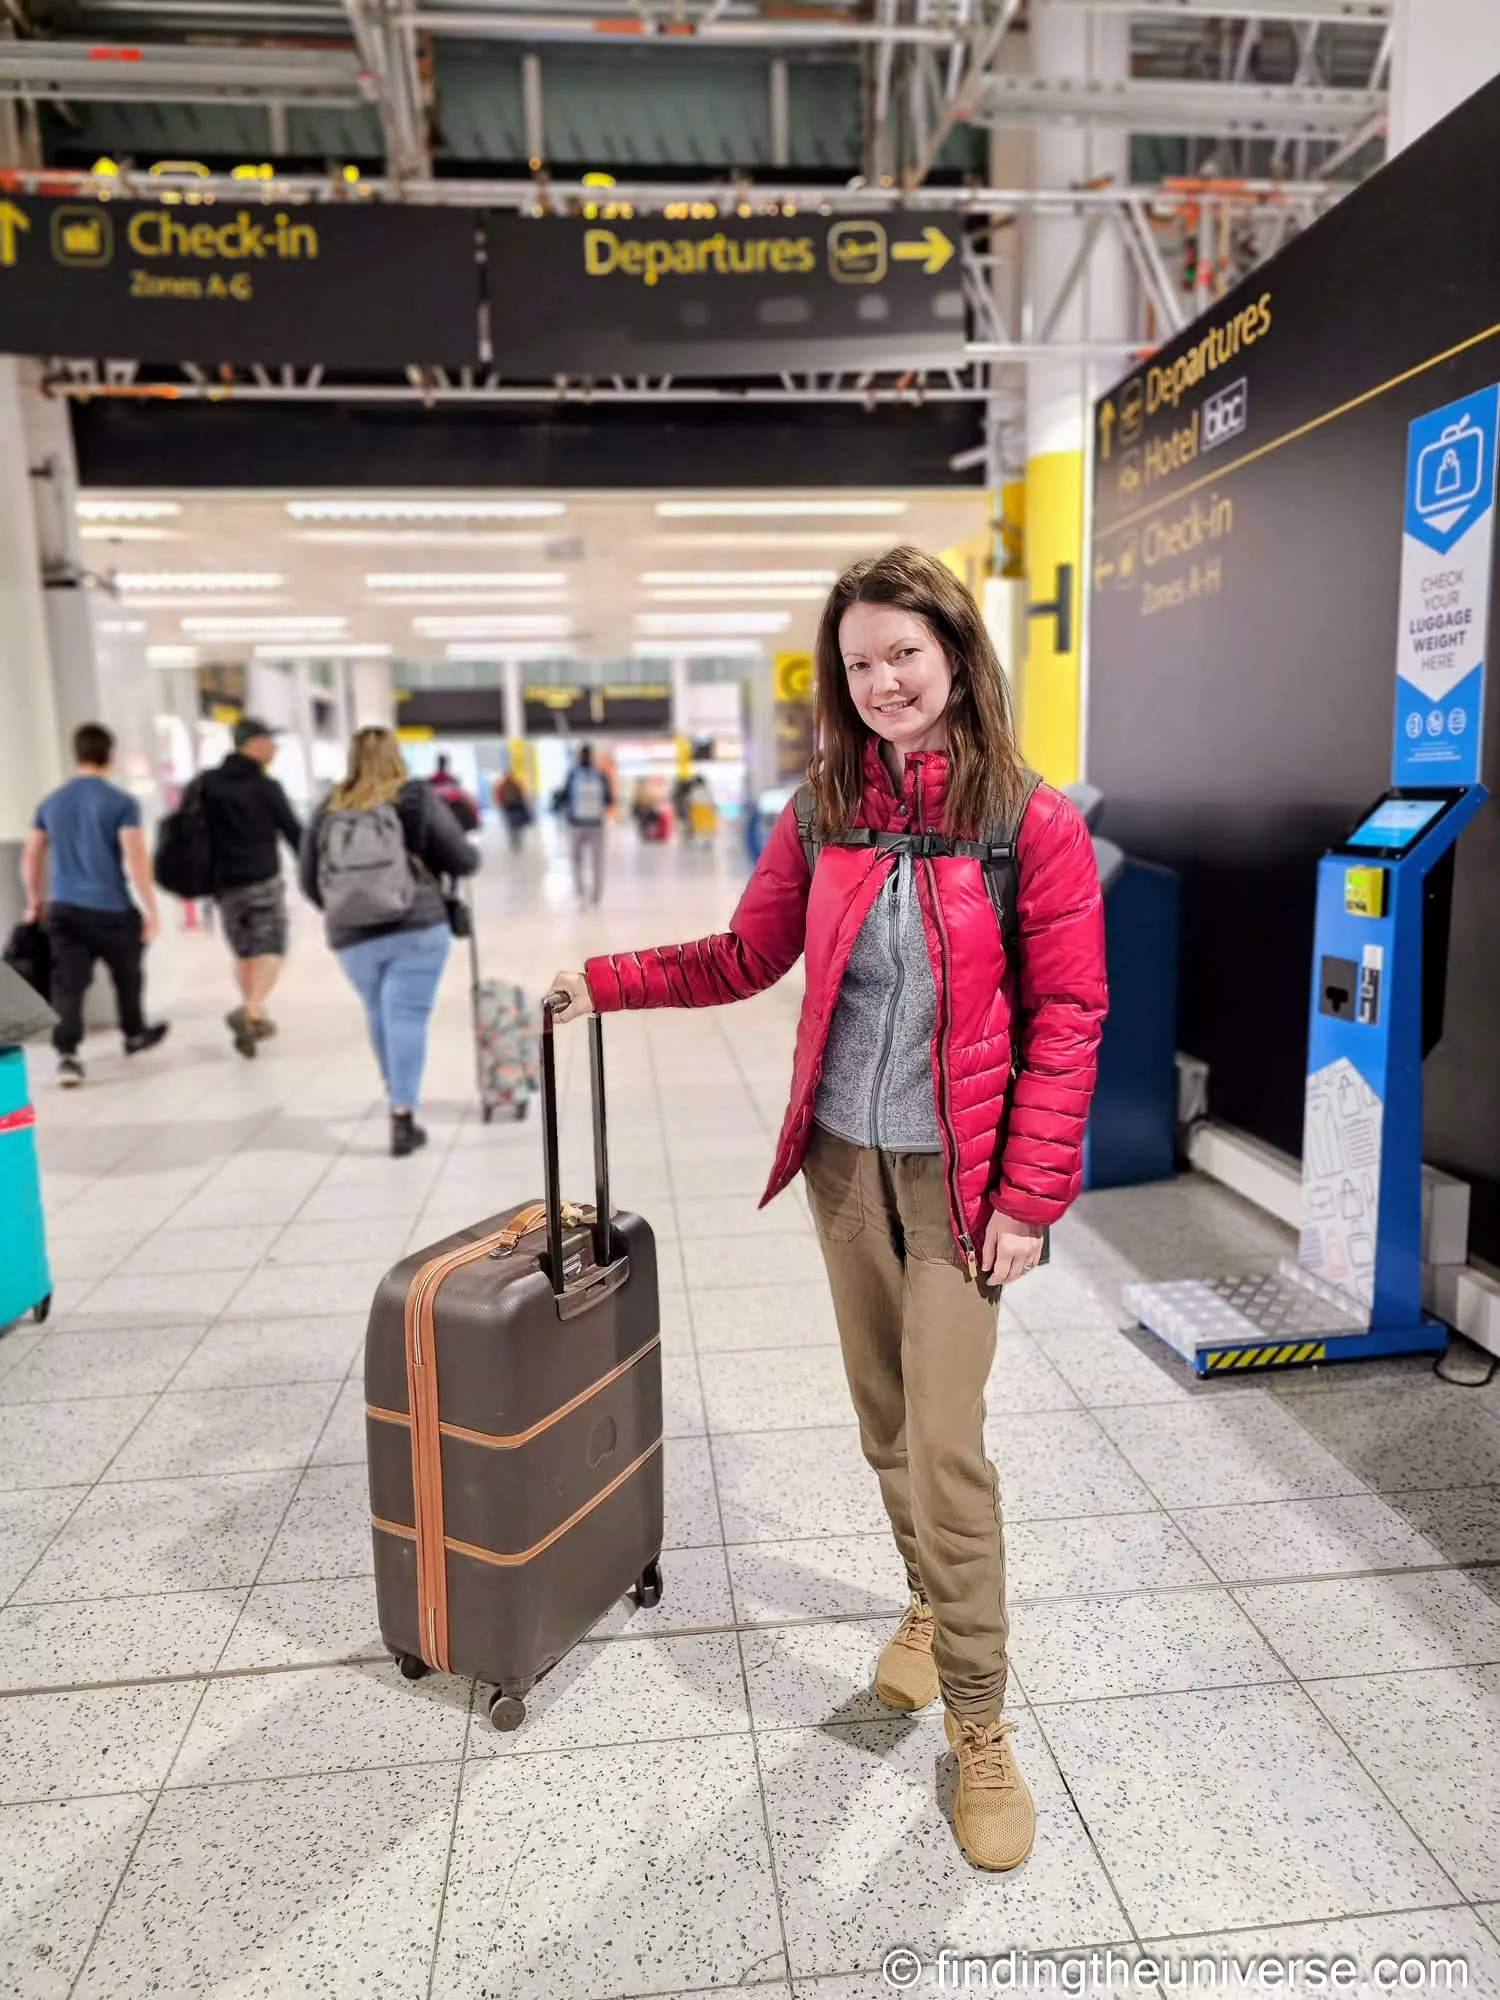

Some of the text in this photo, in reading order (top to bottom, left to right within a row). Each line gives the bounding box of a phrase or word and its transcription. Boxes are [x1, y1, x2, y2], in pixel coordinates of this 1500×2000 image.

[128, 211, 318, 258] Check-in
[584, 228, 815, 285] Departures
[1146, 292, 1271, 414] Departures
[1144, 409, 1199, 483] Hotel
[1141, 491, 1234, 566] Check-in
[1420, 569, 1465, 593] CHECK
[1423, 591, 1460, 612] YOUR
[1409, 608, 1473, 635] LUGGAGE
[1412, 630, 1468, 654] WEIGHT
[1420, 652, 1456, 672] HERE
